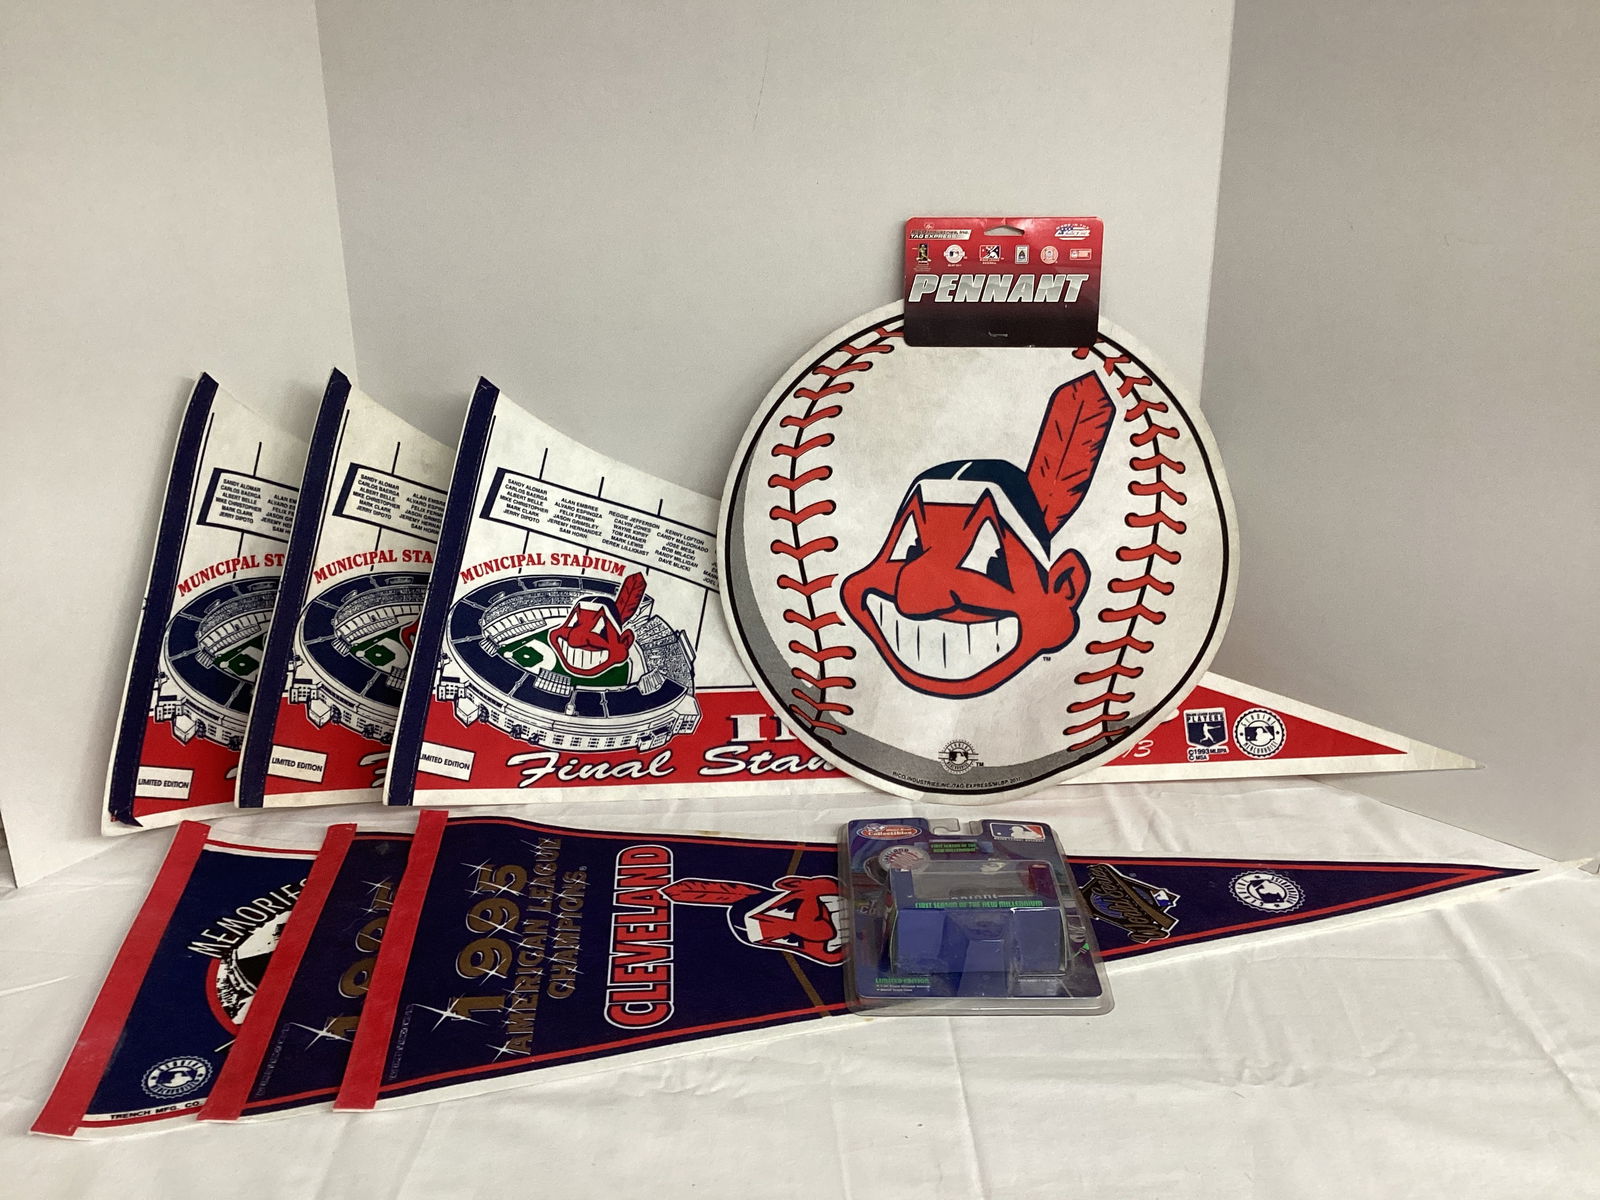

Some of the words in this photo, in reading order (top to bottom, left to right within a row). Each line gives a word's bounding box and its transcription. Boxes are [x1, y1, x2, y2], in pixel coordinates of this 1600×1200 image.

[908, 274, 1090, 303] PENNANT
[358, 480, 378, 490] CARLOS
[505, 484, 525, 494] CARLOS
[526, 491, 548, 502] BAERGA
[508, 479, 524, 488] SANDY
[526, 484, 548, 494] ALOMAR
[500, 495, 512, 503] MIKE
[513, 499, 548, 514] CHRISTOPHER
[507, 492, 526, 501] ALBERT
[528, 498, 544, 506] BELLE
[561, 498, 576, 506] ALAN
[576, 502, 598, 512] EMBREE
[504, 509, 520, 518] JERRY
[521, 514, 540, 524] DIPOTO
[506, 504, 521, 512] MARK
[522, 508, 540, 517] CLARK
[555, 502, 575, 512] ALVARO
[576, 508, 602, 518] ESPINOZA
[560, 509, 574, 518] FELIX
[575, 514, 596, 522] FERMIN
[547, 518, 568, 528] JEREMY
[570, 524, 602, 536] HERNANDEZ
[553, 514, 570, 522] JASON
[572, 519, 599, 530] GRIMSLEY
[609, 510, 628, 520] REGGIE
[630, 516, 660, 530] JEFFERSON
[614, 518, 632, 528] CALVIN
[634, 524, 652, 532] JONES
[614, 524, 632, 533] WAYNE
[632, 530, 648, 538] KIRBY
[624, 534, 646, 544] KRAMER
[665, 529, 682, 538] KENNY
[684, 534, 704, 546] LOFTON
[602, 538, 620, 548] DEREK
[621, 544, 650, 556] LILLIQUIST
[611, 536, 626, 544] MARK
[627, 540, 644, 549] LEWIS
[656, 532, 675, 542] CANDY
[676, 538, 708, 552] MALDONADO
[680, 546, 695, 554] MESA
[654, 550, 673, 560] RANDY
[674, 556, 698, 568] MILLIGAN
[662, 546, 674, 554] BOB
[674, 550, 696, 560] MILACKI
[313, 550, 398, 584] MUNICIPAL
[460, 553, 546, 584] MUNICIPAL
[550, 553, 627, 577] STADIUM
[658, 557, 672, 566] DAVE
[177, 556, 260, 597] MUNICIPAL
[272, 757, 296, 768] LIMITED
[296, 762, 322, 772] EDITION
[444, 759, 470, 770] EDITION
[507, 750, 674, 788] Final
[138, 778, 163, 788] LIMITED
[164, 780, 190, 789] EDITION
[893, 772, 906, 780] RICO
[527, 837, 562, 912] LEAGUE
[1107, 898, 1166, 942] World
[451, 864, 528, 1020] 1995
[546, 870, 587, 999] CHAMPIONS
[604, 844, 674, 1029] CLEVELAND
[506, 919, 548, 1054] AMERICAN
[110, 1110, 150, 1119] TRENCH
[156, 1106, 180, 1114] MFG.
